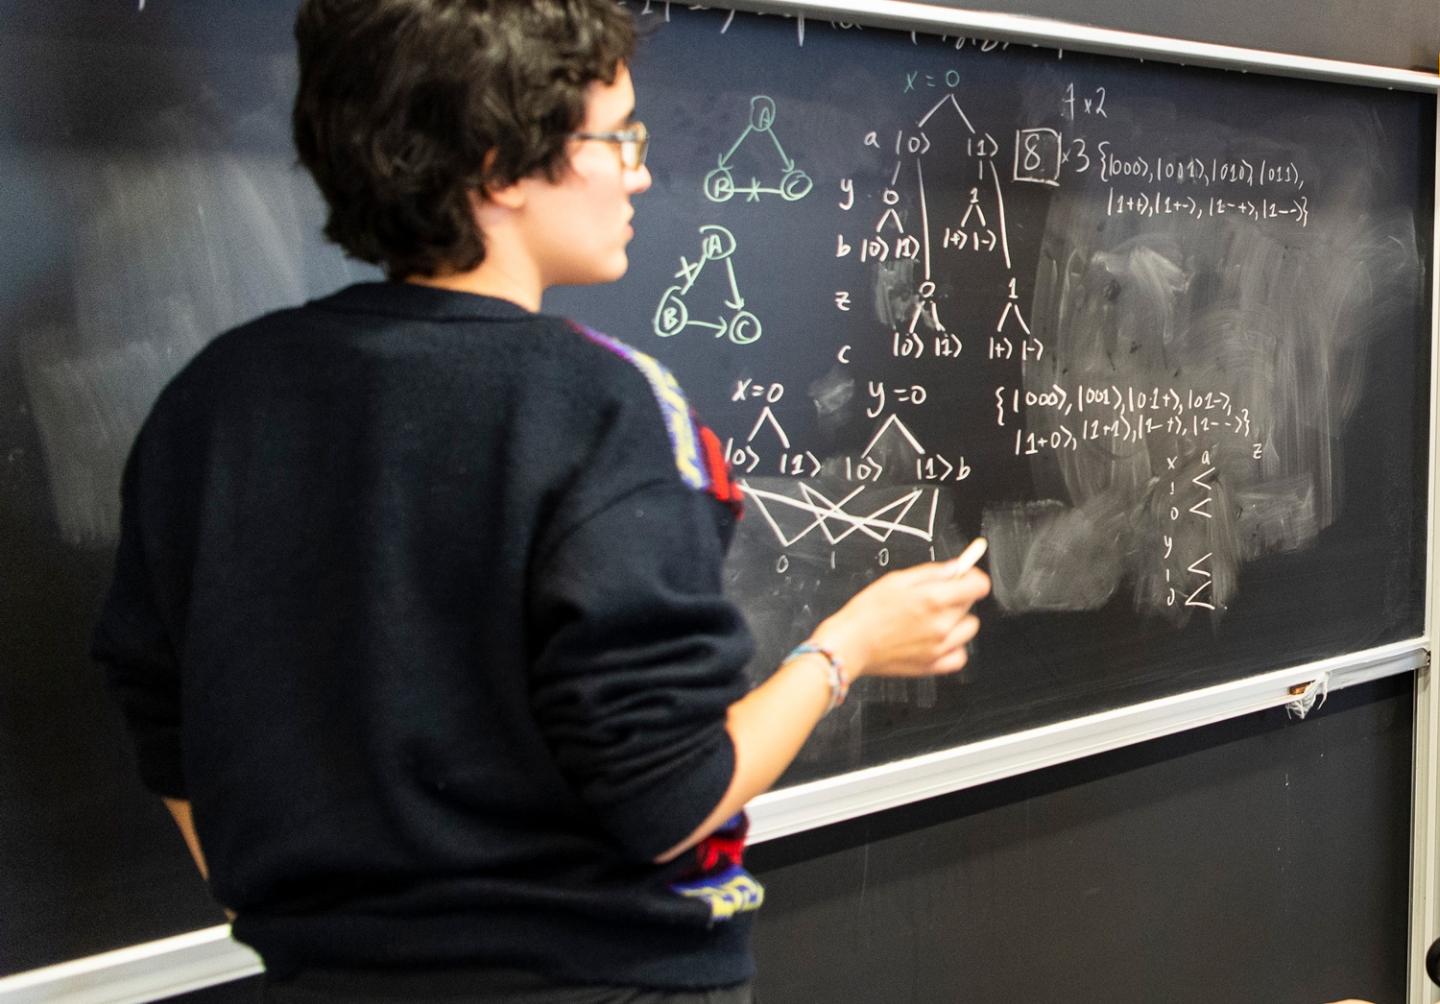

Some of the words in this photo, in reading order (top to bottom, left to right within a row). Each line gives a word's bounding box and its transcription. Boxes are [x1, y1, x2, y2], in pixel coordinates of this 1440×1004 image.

[863, 131, 881, 149] a
[1023, 133, 1041, 171] 8
[839, 178, 855, 210] y
[836, 234, 851, 258] b
